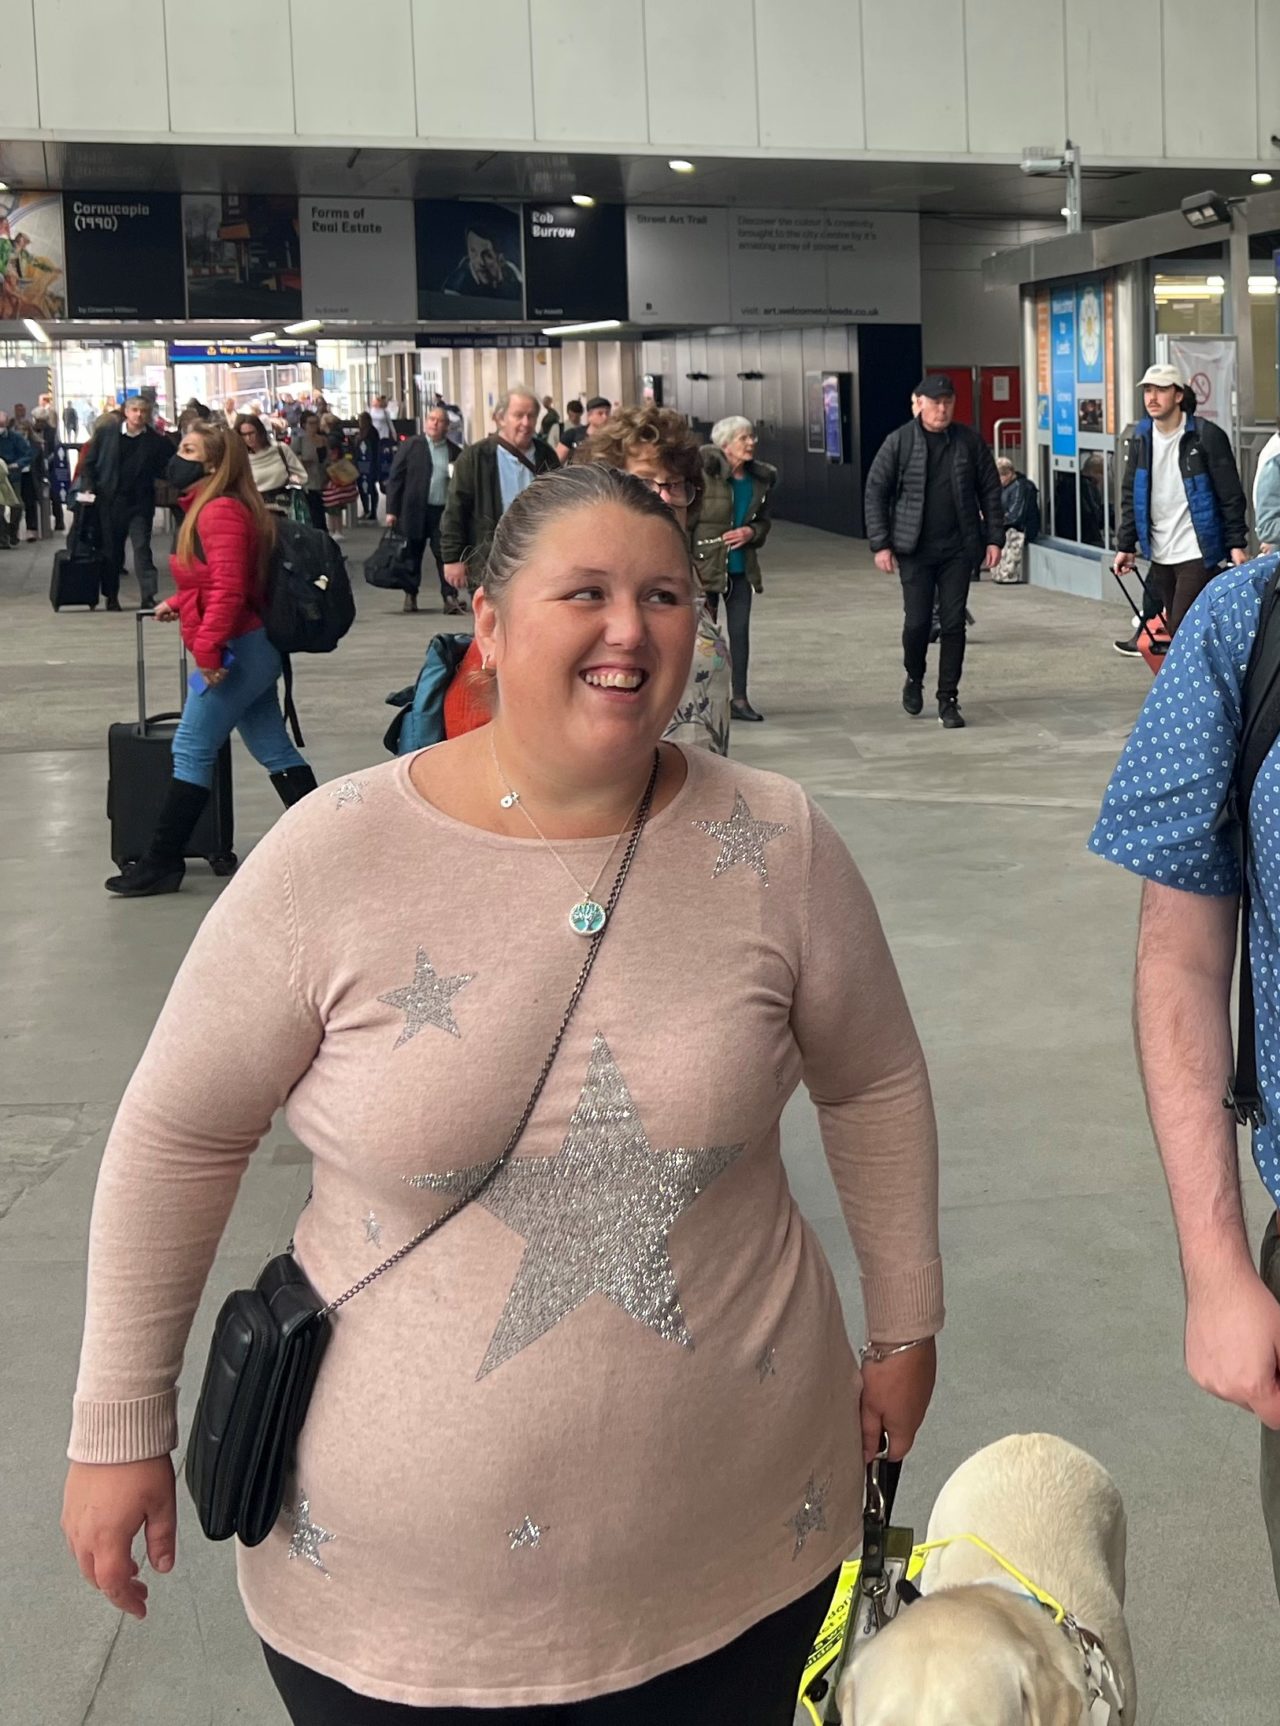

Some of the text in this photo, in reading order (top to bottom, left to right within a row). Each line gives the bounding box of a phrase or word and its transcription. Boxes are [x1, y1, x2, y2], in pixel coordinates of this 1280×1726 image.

[73, 201, 150, 218] Cornucopia
[311, 206, 365, 219] Forms of
[74, 215, 118, 232] (1990)
[531, 210, 554, 224] Rob
[637, 213, 708, 225] Street Art Trail
[312, 221, 382, 234] Real Estate
[532, 225, 576, 239] Burrow
